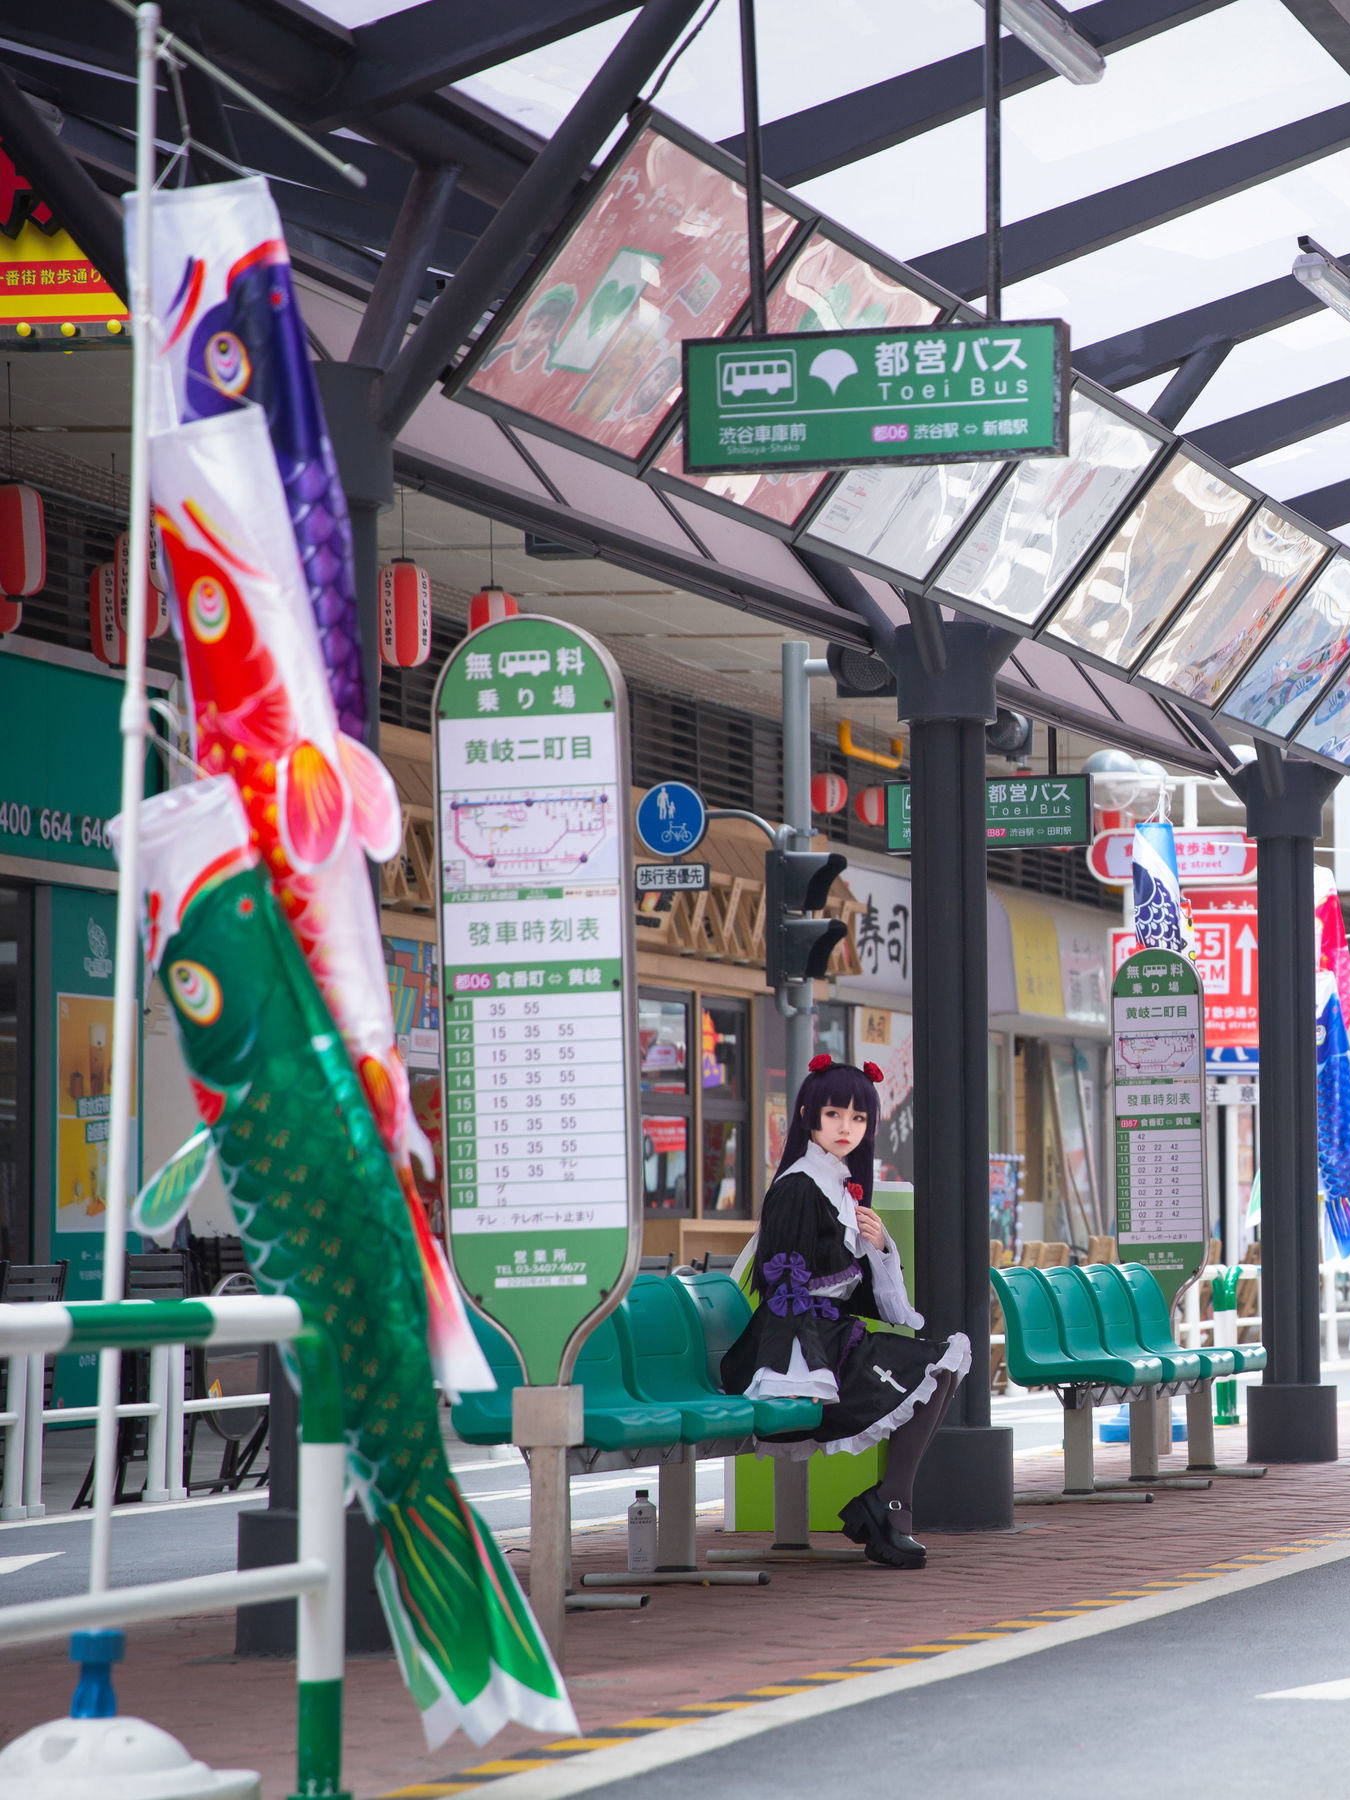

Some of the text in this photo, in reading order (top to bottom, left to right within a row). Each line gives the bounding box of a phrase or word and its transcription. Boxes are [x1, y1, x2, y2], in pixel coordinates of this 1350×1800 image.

[0, 268, 101, 286] 番街 散歩通り
[875, 338, 1028, 377] 都営バス
[878, 377, 1028, 401] Toei Bus
[718, 423, 807, 445] 渋谷車庫前
[874, 419, 1029, 441] 都06 渋谷駅 新橋駅
[477, 684, 576, 713] 乗り場
[464, 736, 593, 765] 黄岐二町目
[988, 783, 1071, 803] 都営バス
[990, 803, 1071, 816] Toei Bus
[40, 807, 72, 843] 664
[1009, 827, 1035, 837] 渋谷駅
[1047, 825, 1072, 836] 田町駅
[639, 866, 704, 886] 歩行者優先
[857, 892, 909, 979] 寿司
[455, 968, 601, 990] 都06 食番町 黄岐
[455, 1002, 539, 1017] 11 35 55
[1125, 1005, 1188, 1020] 黄岐二町目
[455, 1025, 574, 1041] 12 15 35 55
[455, 1048, 574, 1064] 13 15 35 55
[455, 1072, 575, 1087] 14 15 35 55
[456, 1095, 576, 1110] 15 15 35 55
[456, 1118, 576, 1134] 16 15 35 55
[457, 1140, 577, 1157] 17 15 35 55
[458, 1165, 543, 1180] 18 15 35
[458, 1191, 474, 1204] 19
